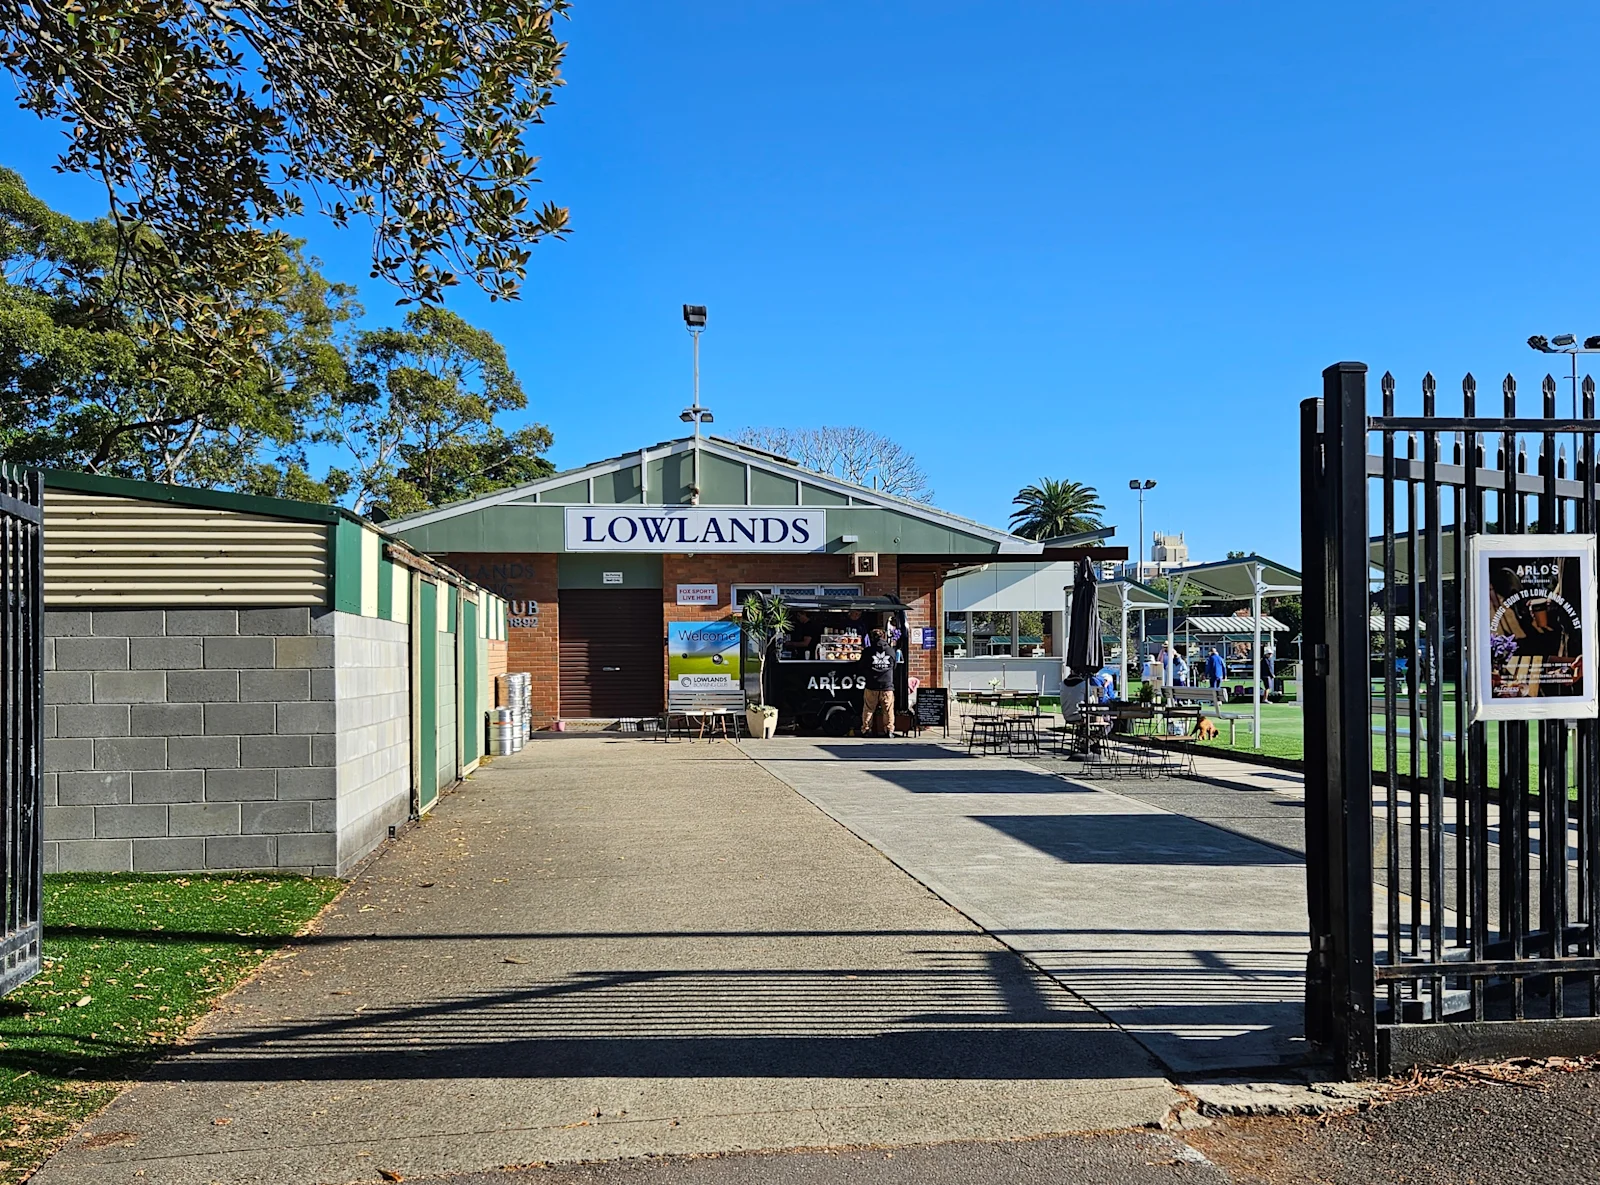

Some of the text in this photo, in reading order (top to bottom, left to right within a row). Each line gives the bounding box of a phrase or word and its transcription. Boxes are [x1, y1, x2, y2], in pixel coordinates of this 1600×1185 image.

[582, 516, 810, 544] LOWLANDS
[1516, 563, 1560, 576] ARLO'S
[1490, 605, 1506, 632] COMING
[1503, 593, 1520, 608] SOON
[1520, 590, 1529, 599] TO
[1529, 588, 1565, 606] LOWLANDS
[1562, 601, 1577, 617] MAY
[509, 617, 539, 628] 1892
[678, 630, 736, 641] Welcome
[807, 674, 867, 690] ARLO'S
